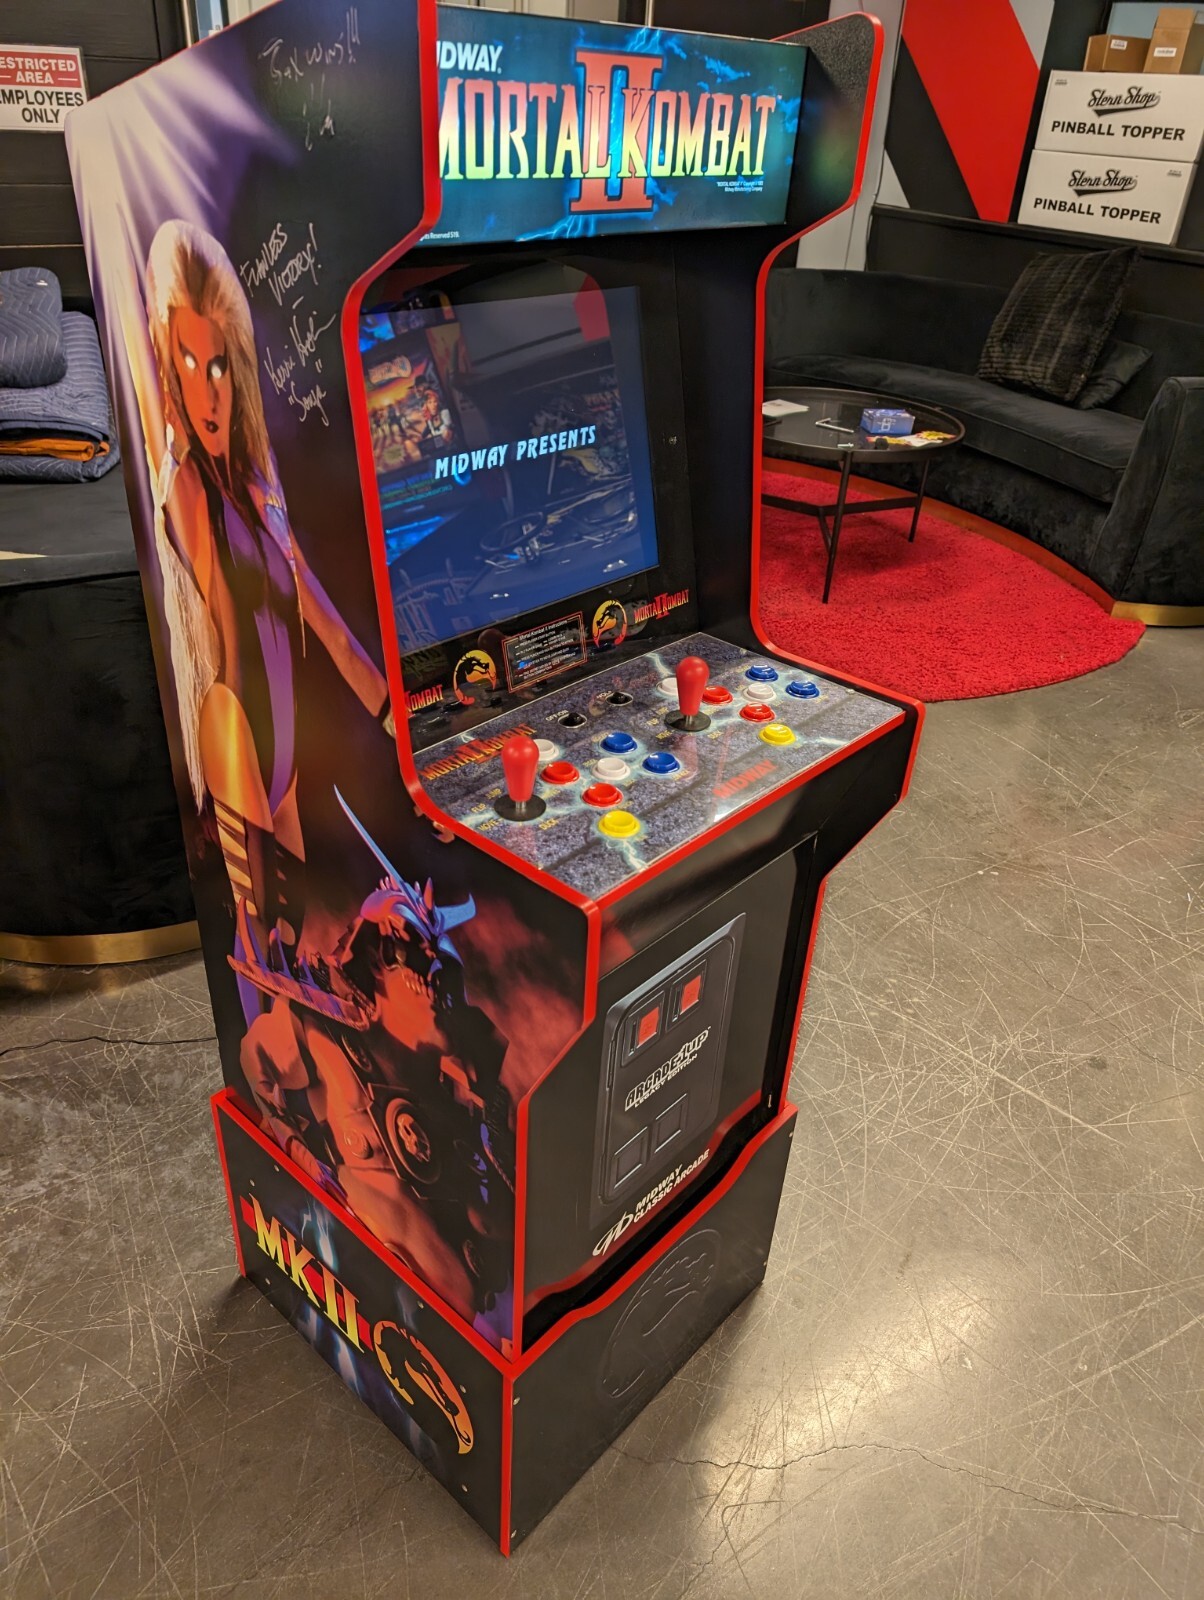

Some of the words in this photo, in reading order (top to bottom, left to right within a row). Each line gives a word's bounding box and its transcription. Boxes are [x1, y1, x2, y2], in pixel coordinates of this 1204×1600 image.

[0, 57, 77, 72] ESTRICTED
[16, 71, 54, 84] AREA
[0, 89, 84, 107] MPLOYEES
[1088, 88, 1122, 107] Stern
[1123, 86, 1157, 107] Shop
[21, 107, 60, 123] ONLY
[617, 86, 777, 178] KOMBAT
[1051, 121, 1115, 136] PINBALL
[1121, 125, 1185, 141] TOPPER
[1068, 170, 1101, 187] Stern
[1102, 168, 1134, 190] Shop
[1033, 197, 1094, 216] PINBALL
[1100, 206, 1161, 224] TOPPER
[435, 444, 508, 479] MIDWAY
[516, 425, 596, 461] PRESENTS
[633, 600, 662, 624] MORTAL
[661, 588, 689, 612] KOMBAT
[713, 759, 778, 799] MIDWAY
[634, 1079, 666, 1108] LEGACY
[667, 1052, 698, 1081] EDITION
[633, 1182, 674, 1224] CLASSIC
[673, 1148, 710, 1188] ARCADE
[635, 1163, 683, 1213] MIDWAY
